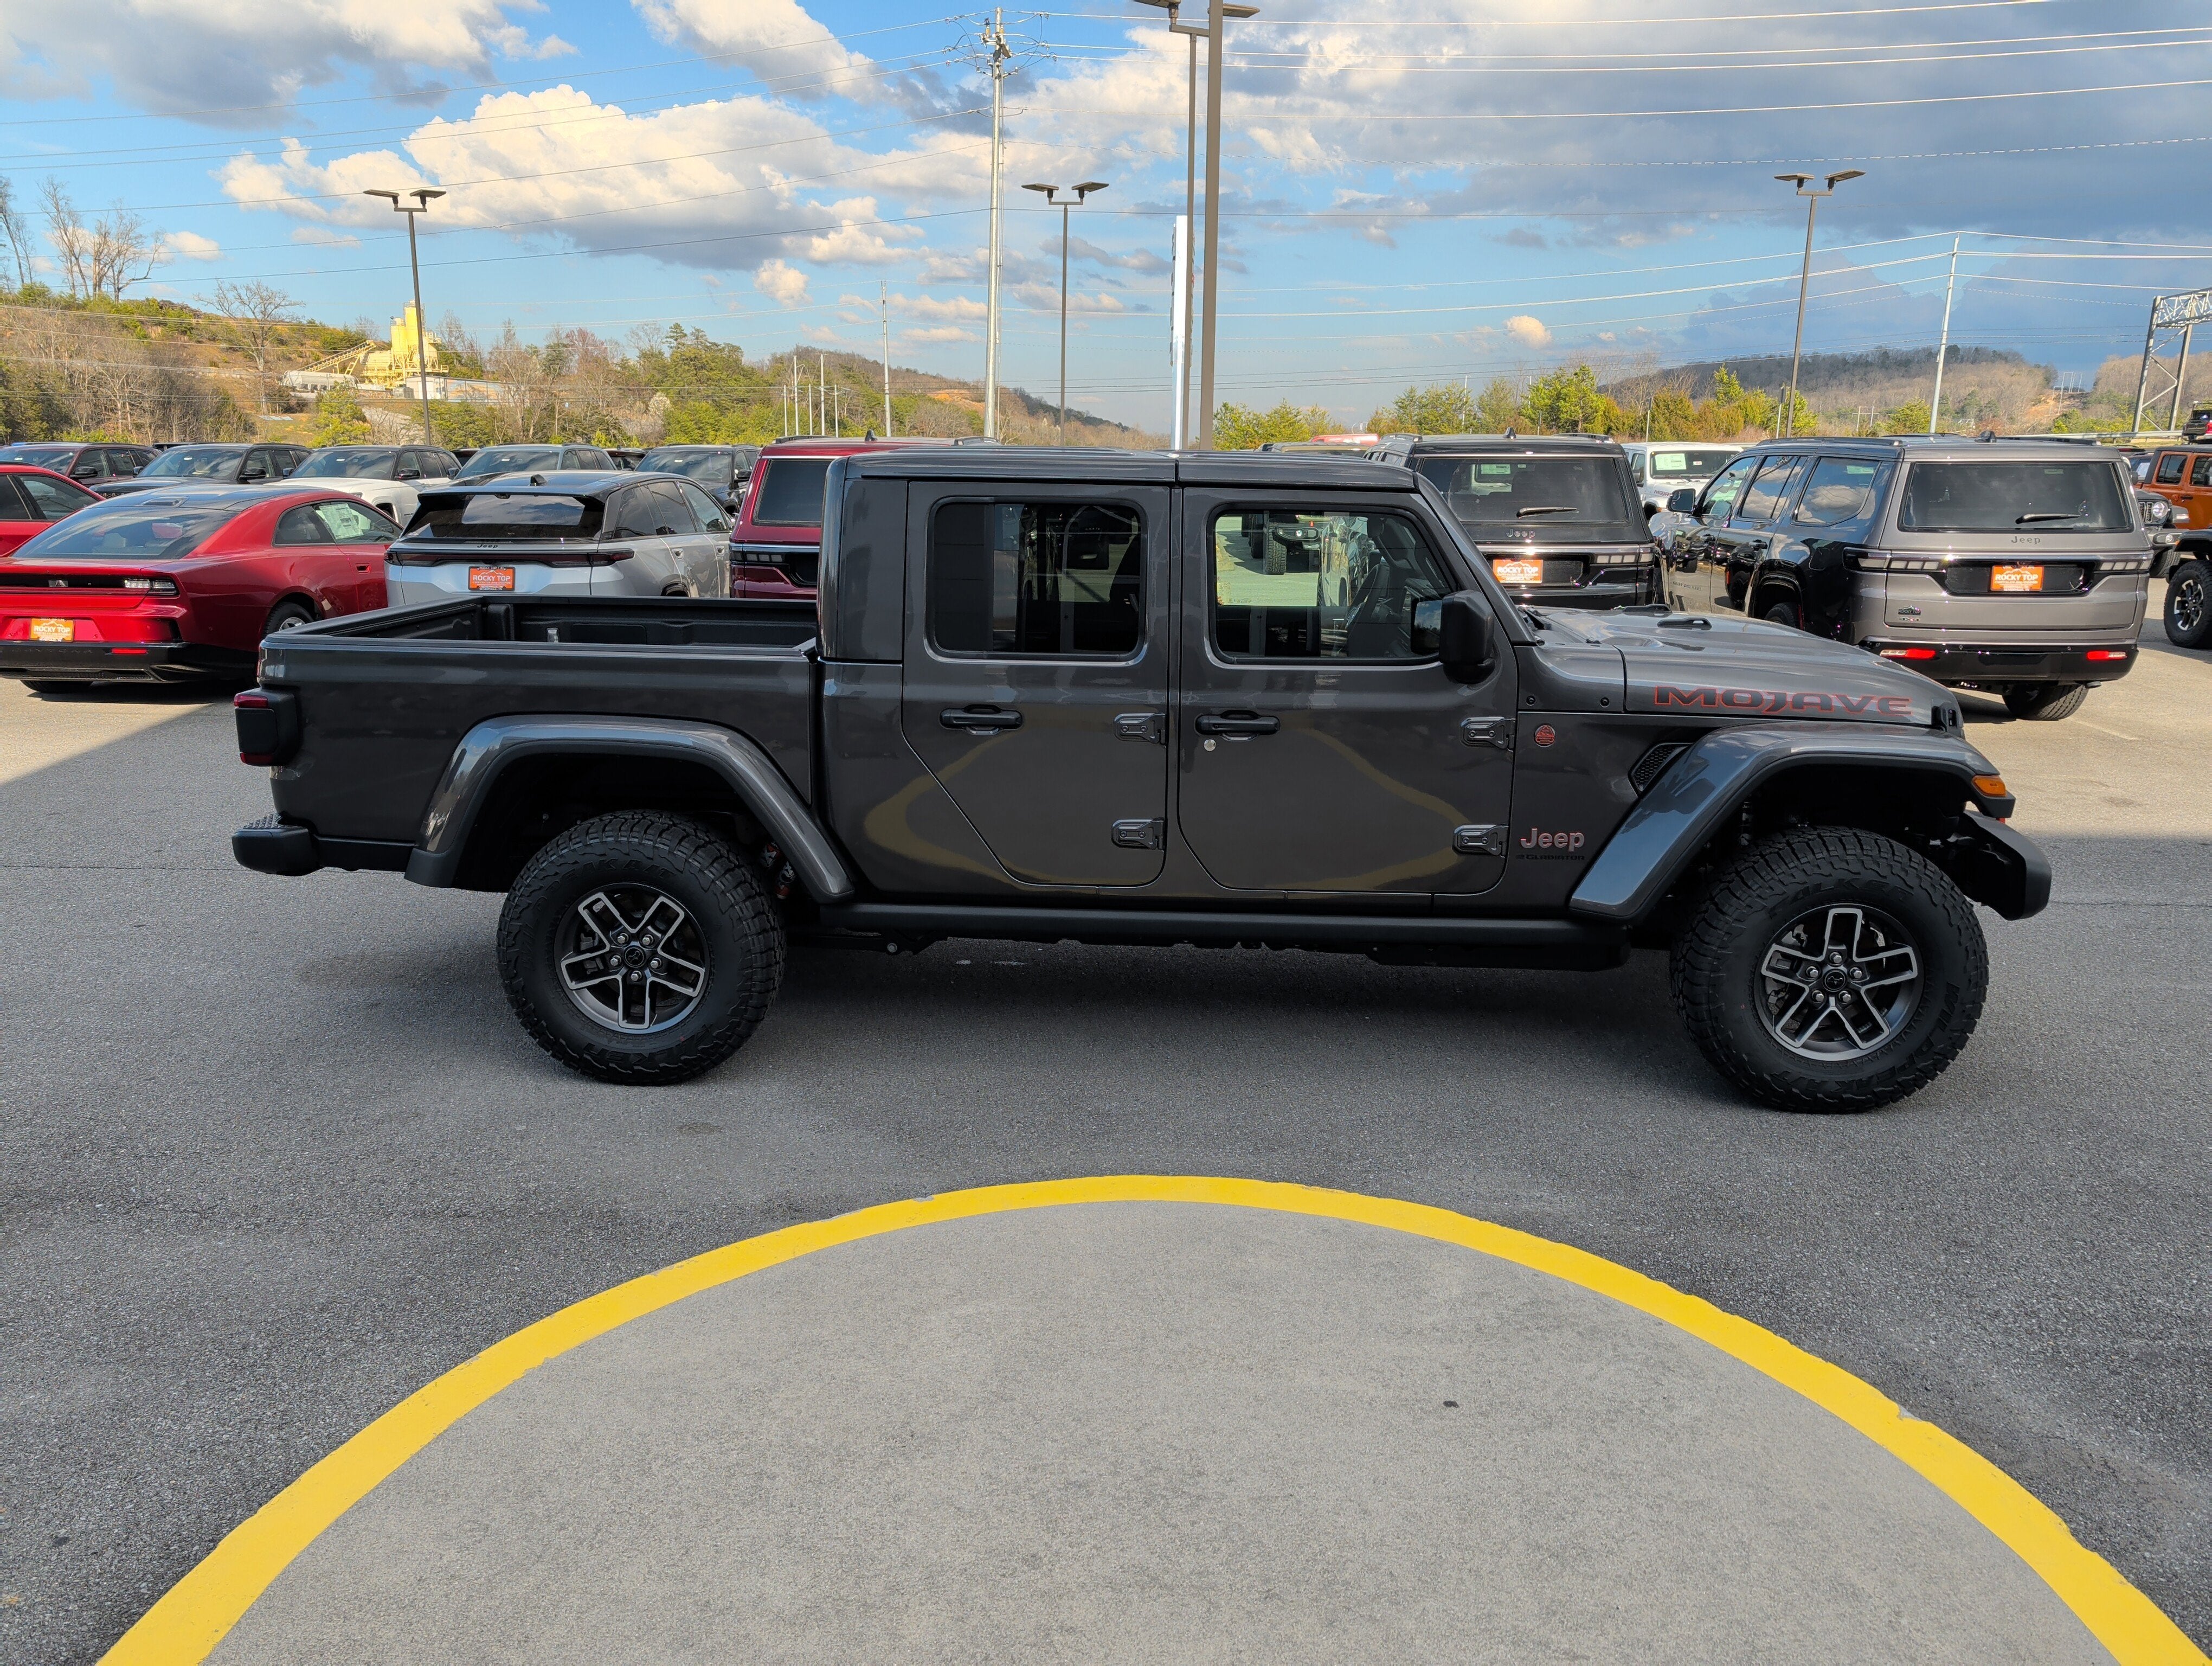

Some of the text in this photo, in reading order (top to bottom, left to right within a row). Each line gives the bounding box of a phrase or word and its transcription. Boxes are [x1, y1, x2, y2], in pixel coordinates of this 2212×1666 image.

[1506, 529, 1535, 538] Jeep
[2011, 536, 2041, 544] Jeep
[1654, 685, 1913, 715] MOJAVE
[1520, 828, 1585, 852] Jeep
